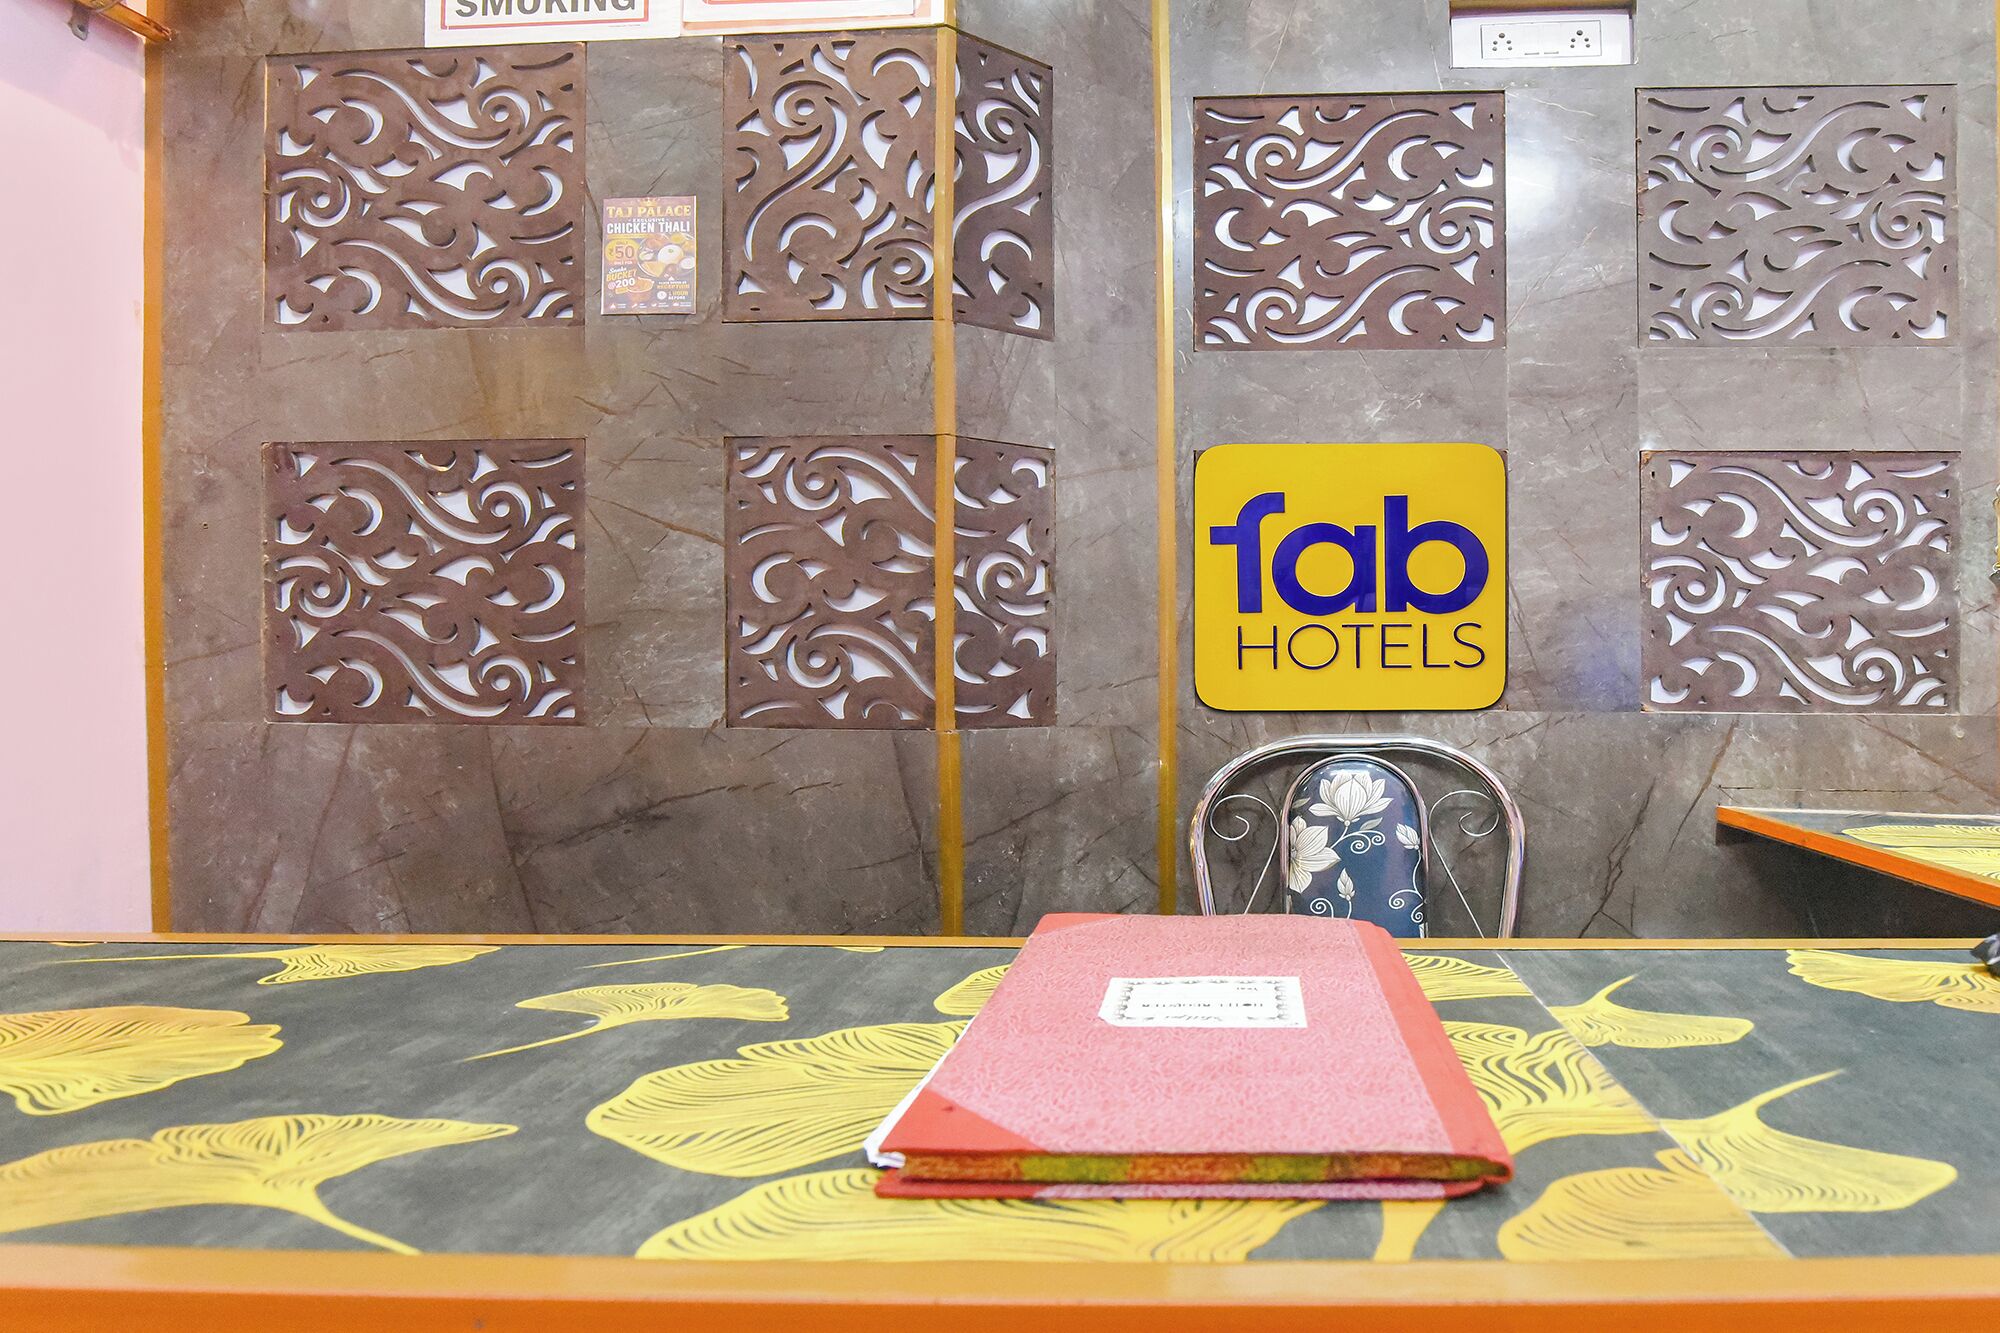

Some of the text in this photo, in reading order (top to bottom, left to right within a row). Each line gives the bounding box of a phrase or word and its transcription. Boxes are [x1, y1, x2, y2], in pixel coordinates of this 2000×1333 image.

[606, 205, 691, 218] TAJ PALACE
[606, 220, 690, 234] CHICKEN THALI
[606, 269, 637, 281] BUCKET
[1209, 491, 1489, 617] fab
[1237, 622, 1486, 671] HOTELS
